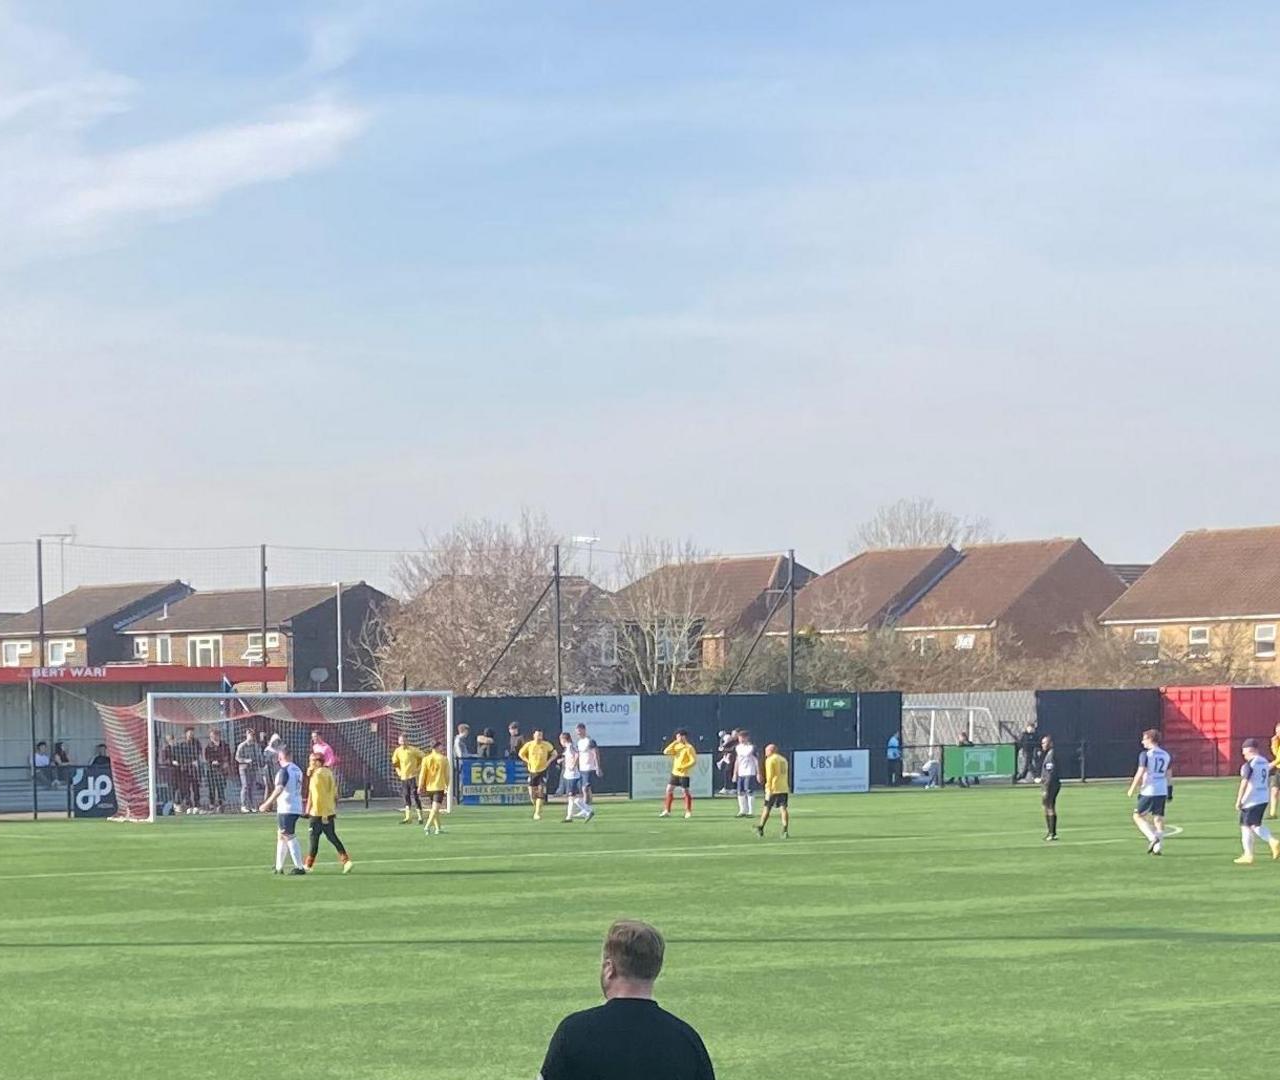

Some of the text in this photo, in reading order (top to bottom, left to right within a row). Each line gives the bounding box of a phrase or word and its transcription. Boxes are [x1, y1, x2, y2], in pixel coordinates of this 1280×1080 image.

[564, 701, 629, 715] BirkettLong
[811, 755, 832, 769] UBS
[1154, 758, 1165, 773] 12
[471, 766, 507, 784] ECS
[1261, 768, 1267, 784] 9
